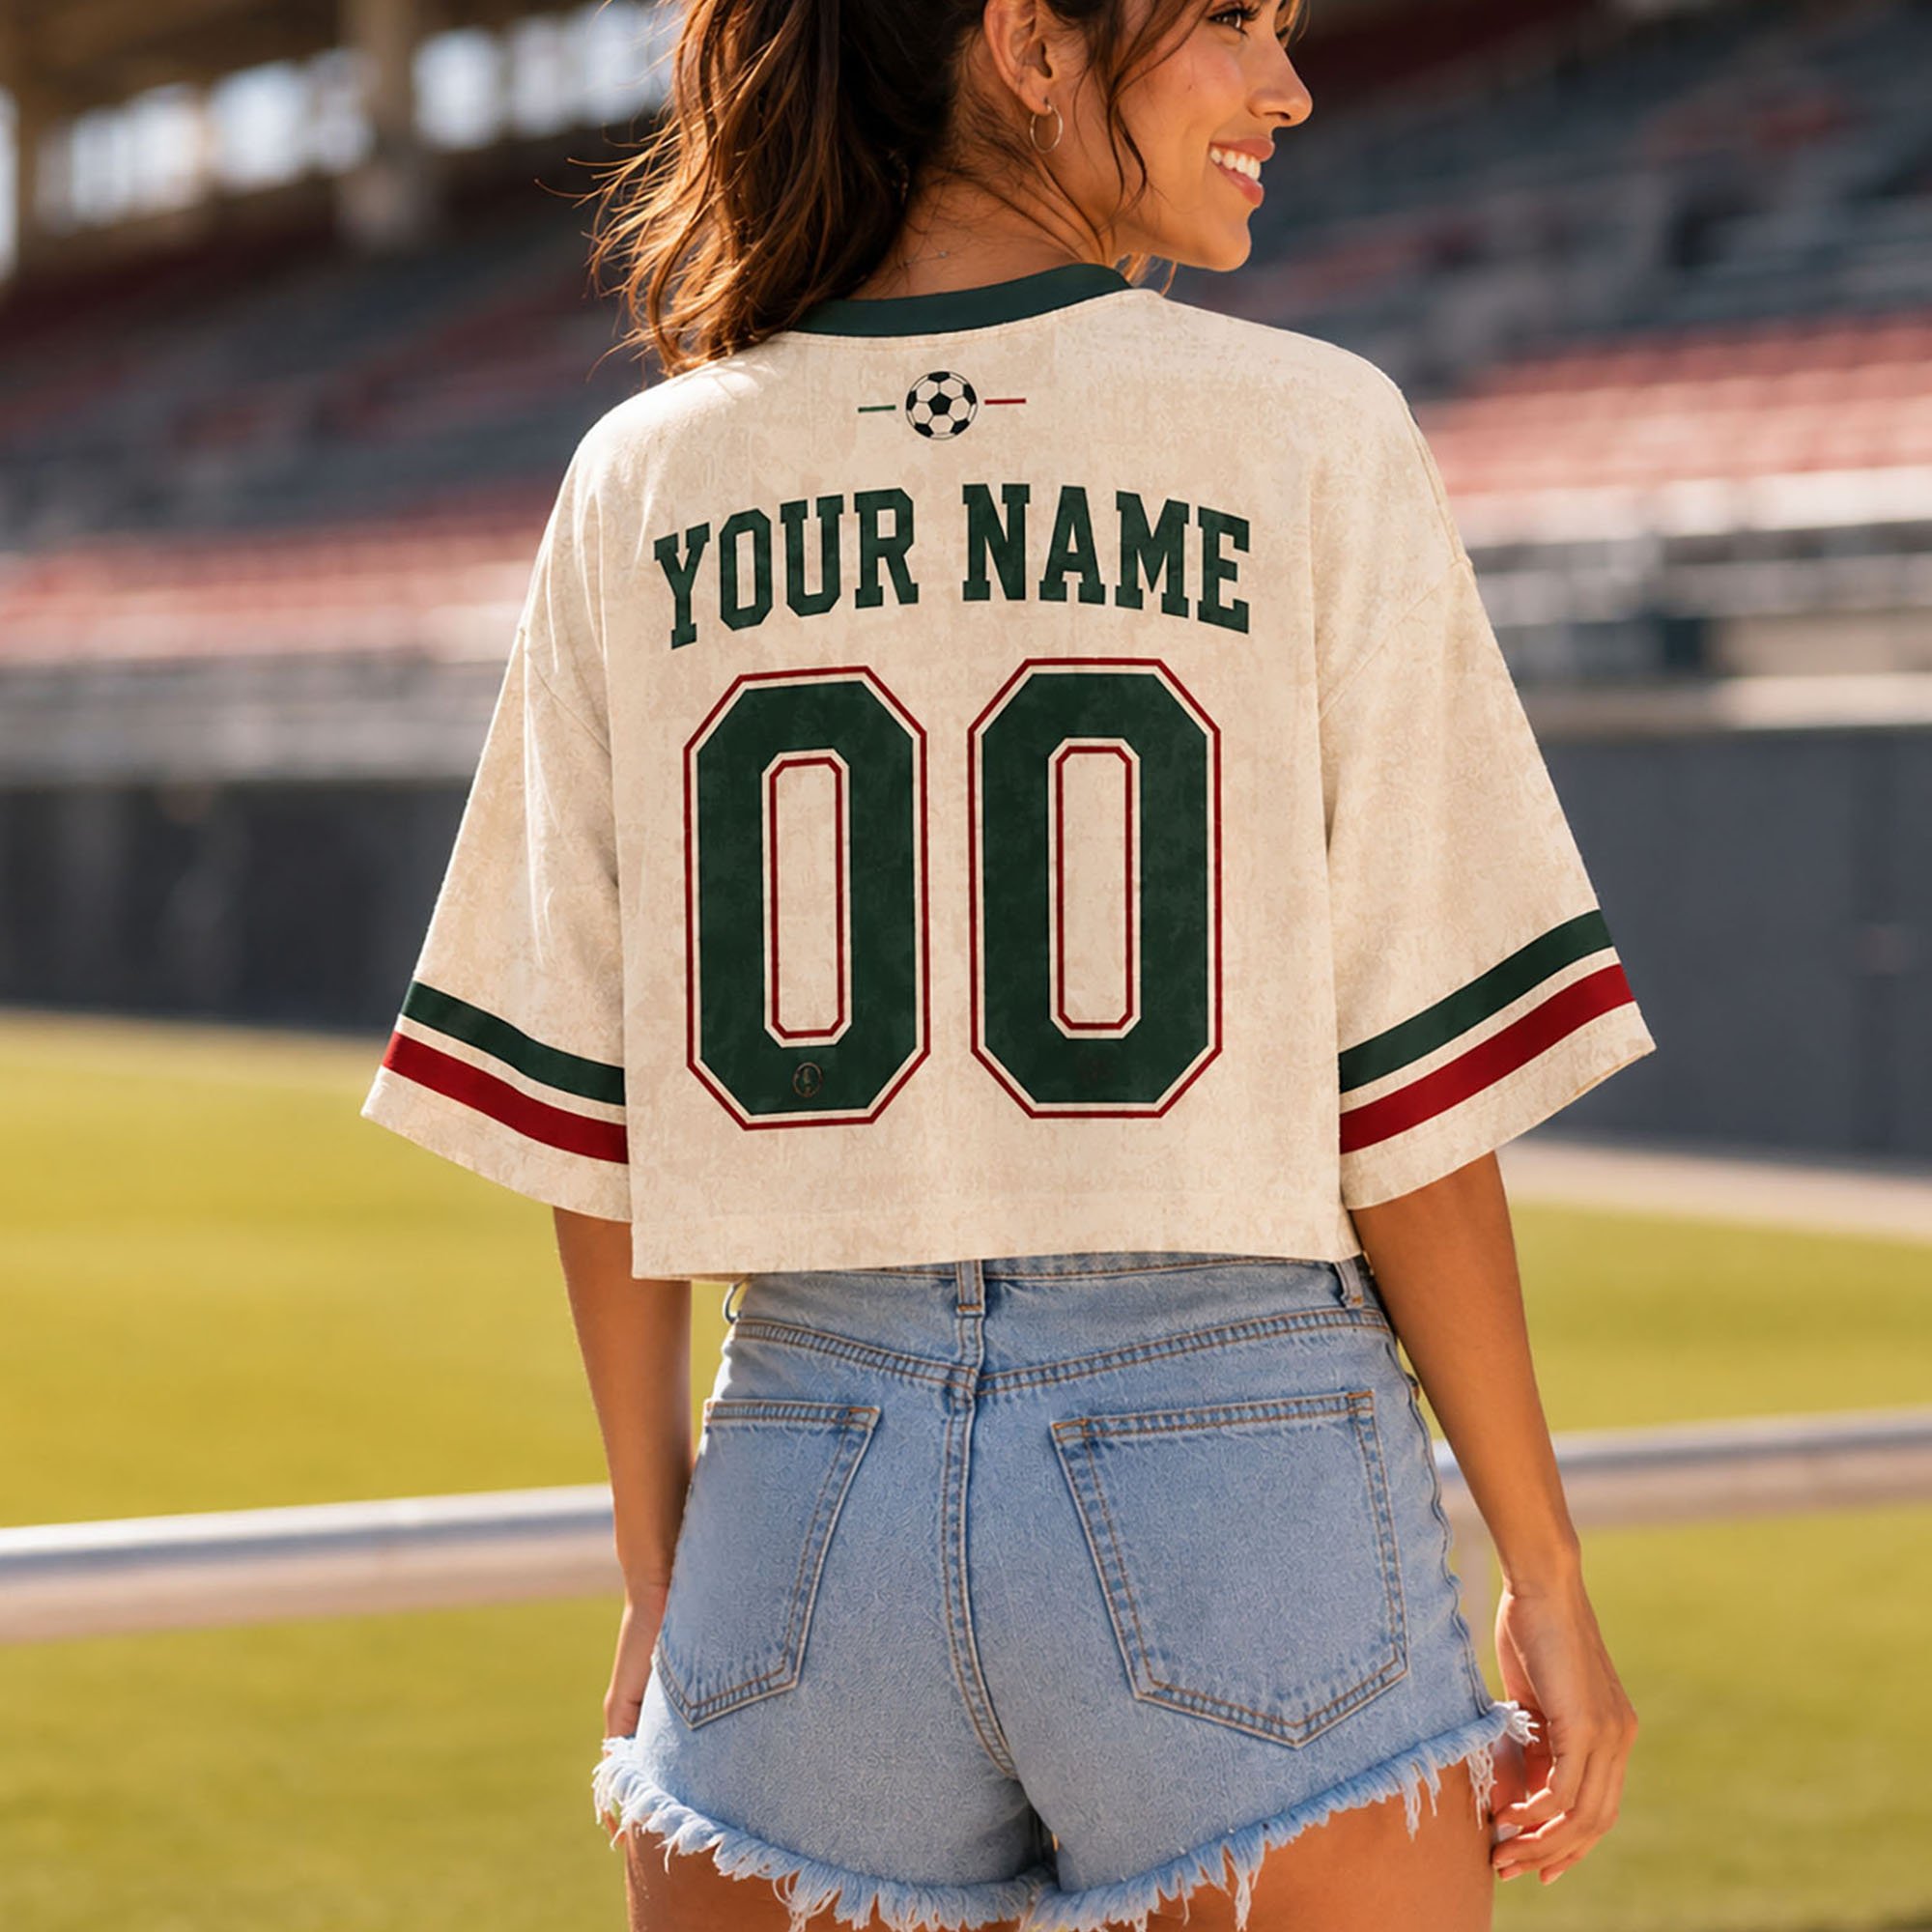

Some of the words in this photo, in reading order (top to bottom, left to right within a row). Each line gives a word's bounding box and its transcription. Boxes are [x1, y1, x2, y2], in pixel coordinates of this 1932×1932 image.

[653, 487, 920, 650] YOUR
[961, 483, 1250, 635] NAME
[684, 658, 1223, 1131] 00
